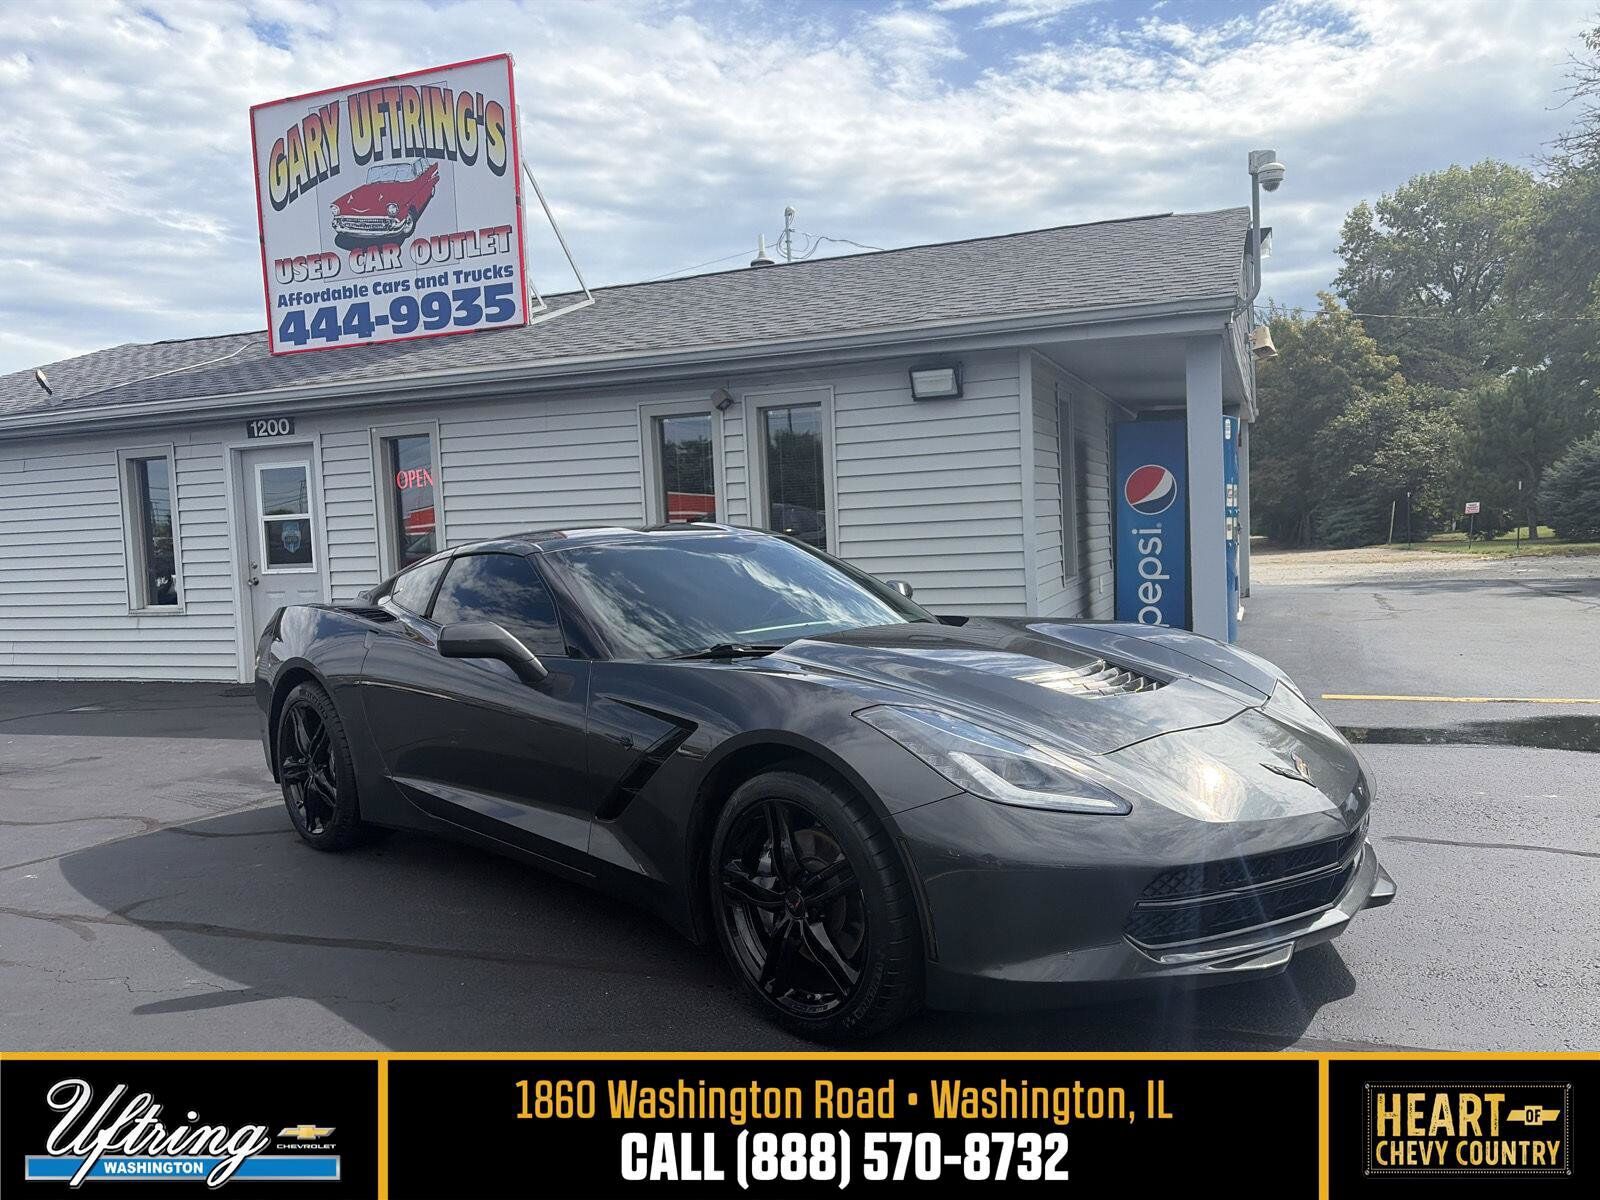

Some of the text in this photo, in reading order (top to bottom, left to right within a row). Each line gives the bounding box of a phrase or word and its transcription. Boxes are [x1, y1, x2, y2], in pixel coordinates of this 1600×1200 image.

[268, 85, 507, 211] GARY UFTRING'S
[274, 224, 513, 284] USED CAR OUTLET
[277, 262, 514, 308] Affordable Cars and Trucks
[279, 282, 516, 346] 444-9935
[250, 418, 290, 437] 1200
[396, 467, 433, 490] OPEN
